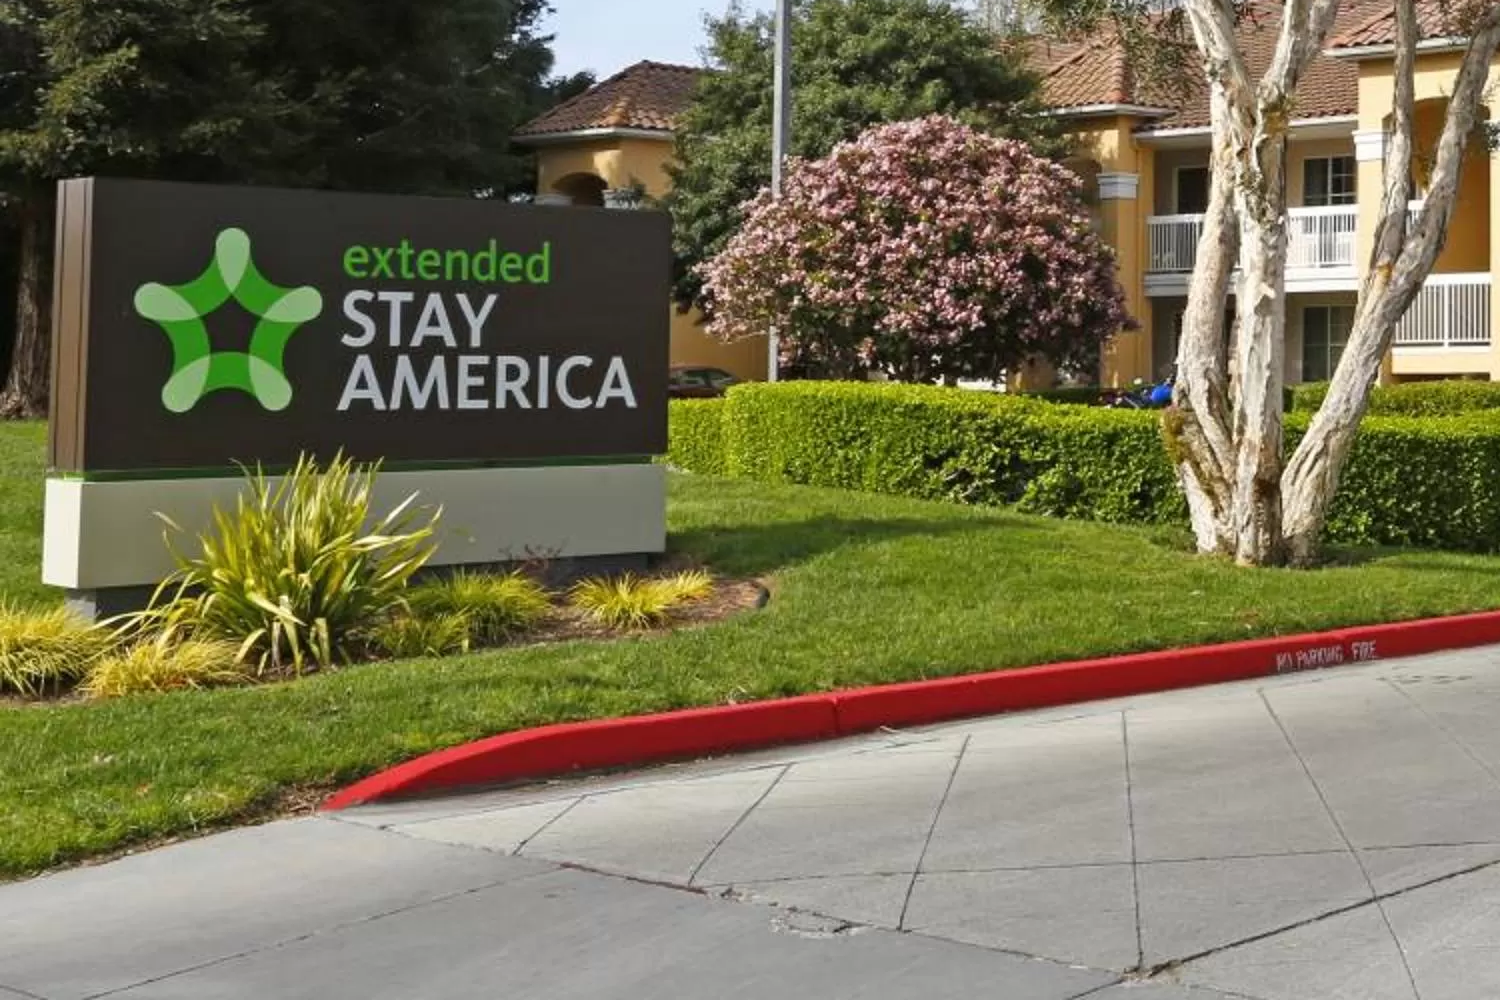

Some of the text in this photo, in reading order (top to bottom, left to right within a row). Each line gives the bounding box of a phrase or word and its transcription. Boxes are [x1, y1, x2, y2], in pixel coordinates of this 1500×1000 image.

[343, 239, 550, 283] extended
[341, 289, 498, 348] STAY
[337, 355, 638, 412] AMERICA
[1296, 644, 1344, 669] PARKING
